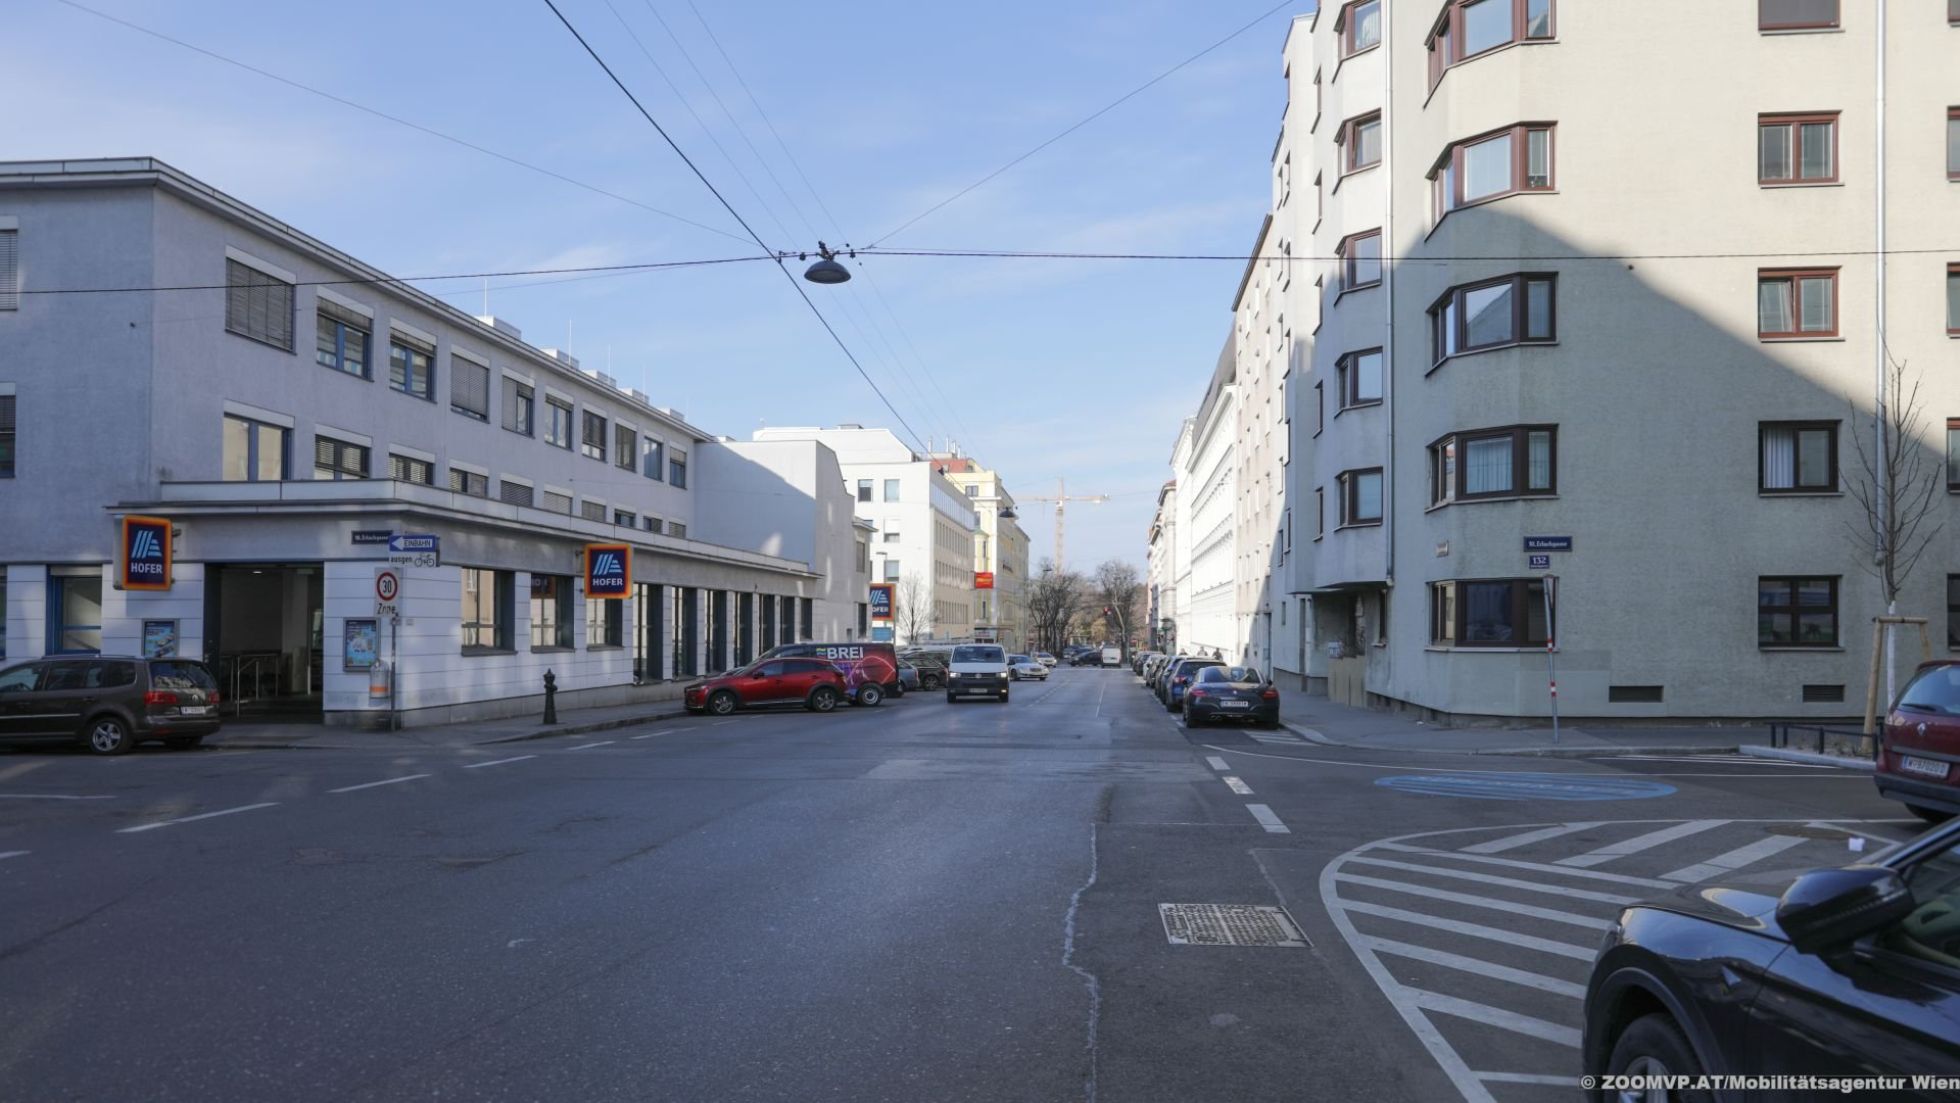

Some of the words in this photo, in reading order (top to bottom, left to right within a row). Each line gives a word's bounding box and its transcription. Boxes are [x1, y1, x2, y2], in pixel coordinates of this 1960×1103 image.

[130, 562, 163, 574] HOFER
[382, 580, 392, 593] 30
[592, 577, 623, 587] HOFER
[827, 646, 864, 660] BREI
